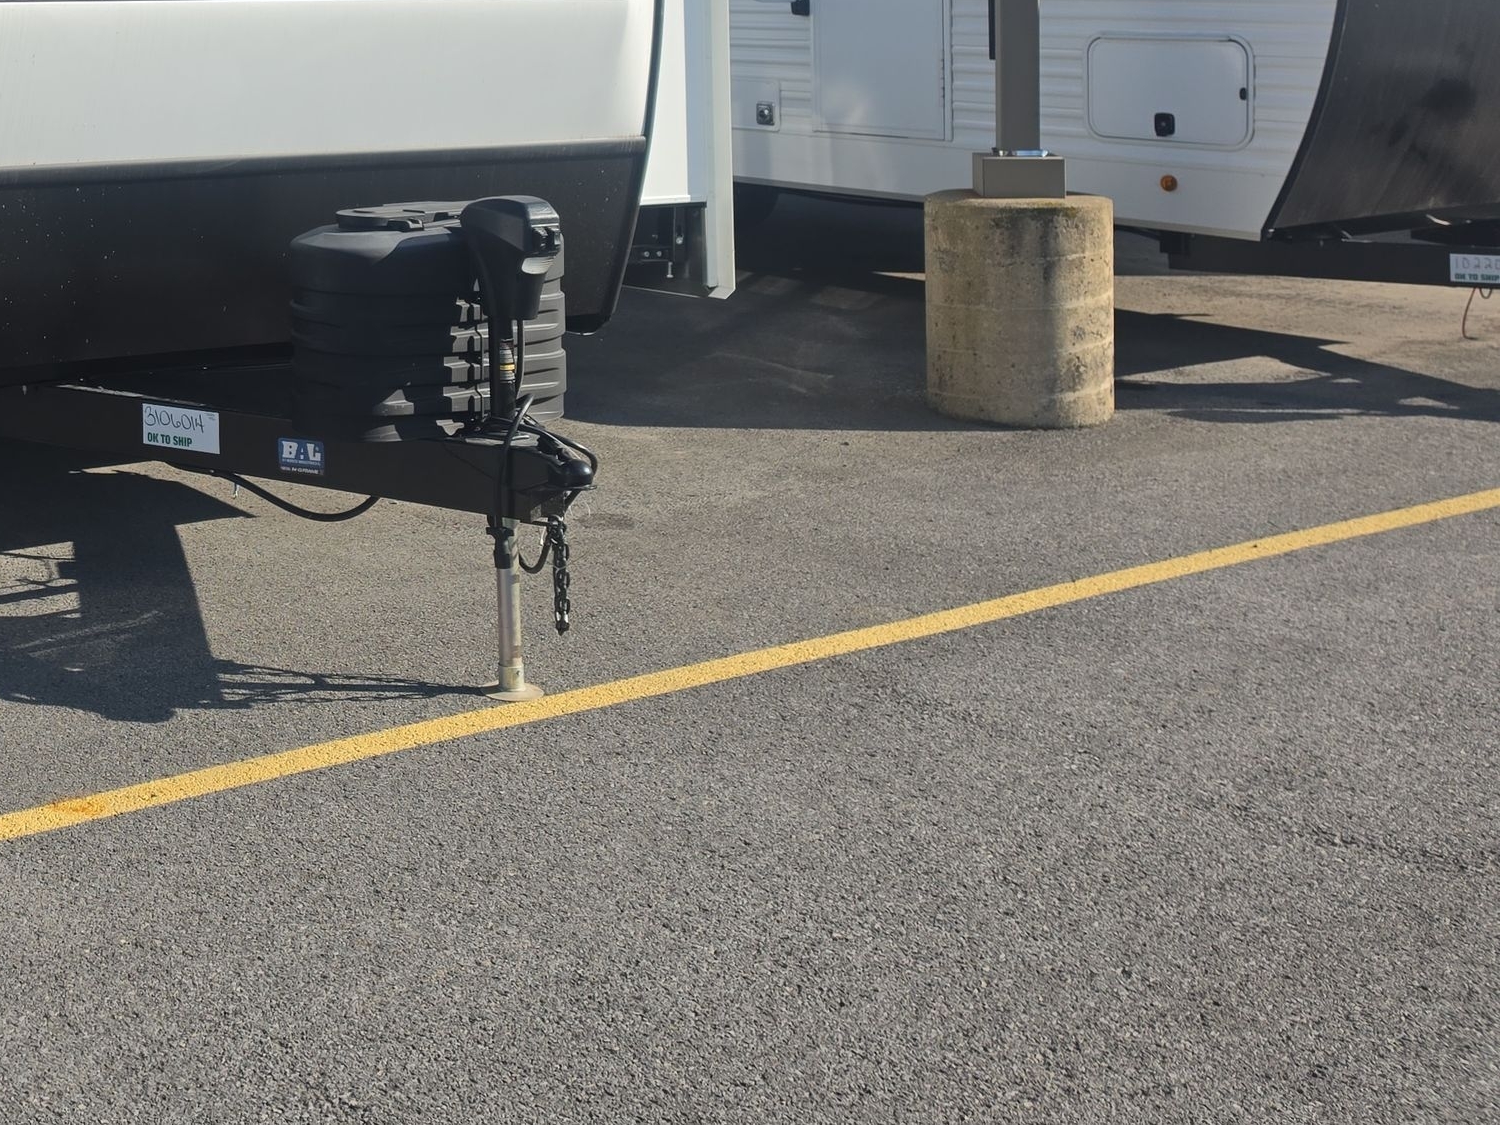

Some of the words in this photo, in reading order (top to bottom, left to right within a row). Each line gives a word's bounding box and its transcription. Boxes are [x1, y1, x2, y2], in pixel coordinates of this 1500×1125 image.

[1468, 273, 1479, 281] TO
[144, 405, 205, 434] 3106014
[147, 432, 159, 444] OK
[160, 434, 171, 445] TO
[172, 436, 192, 448] SHIP
